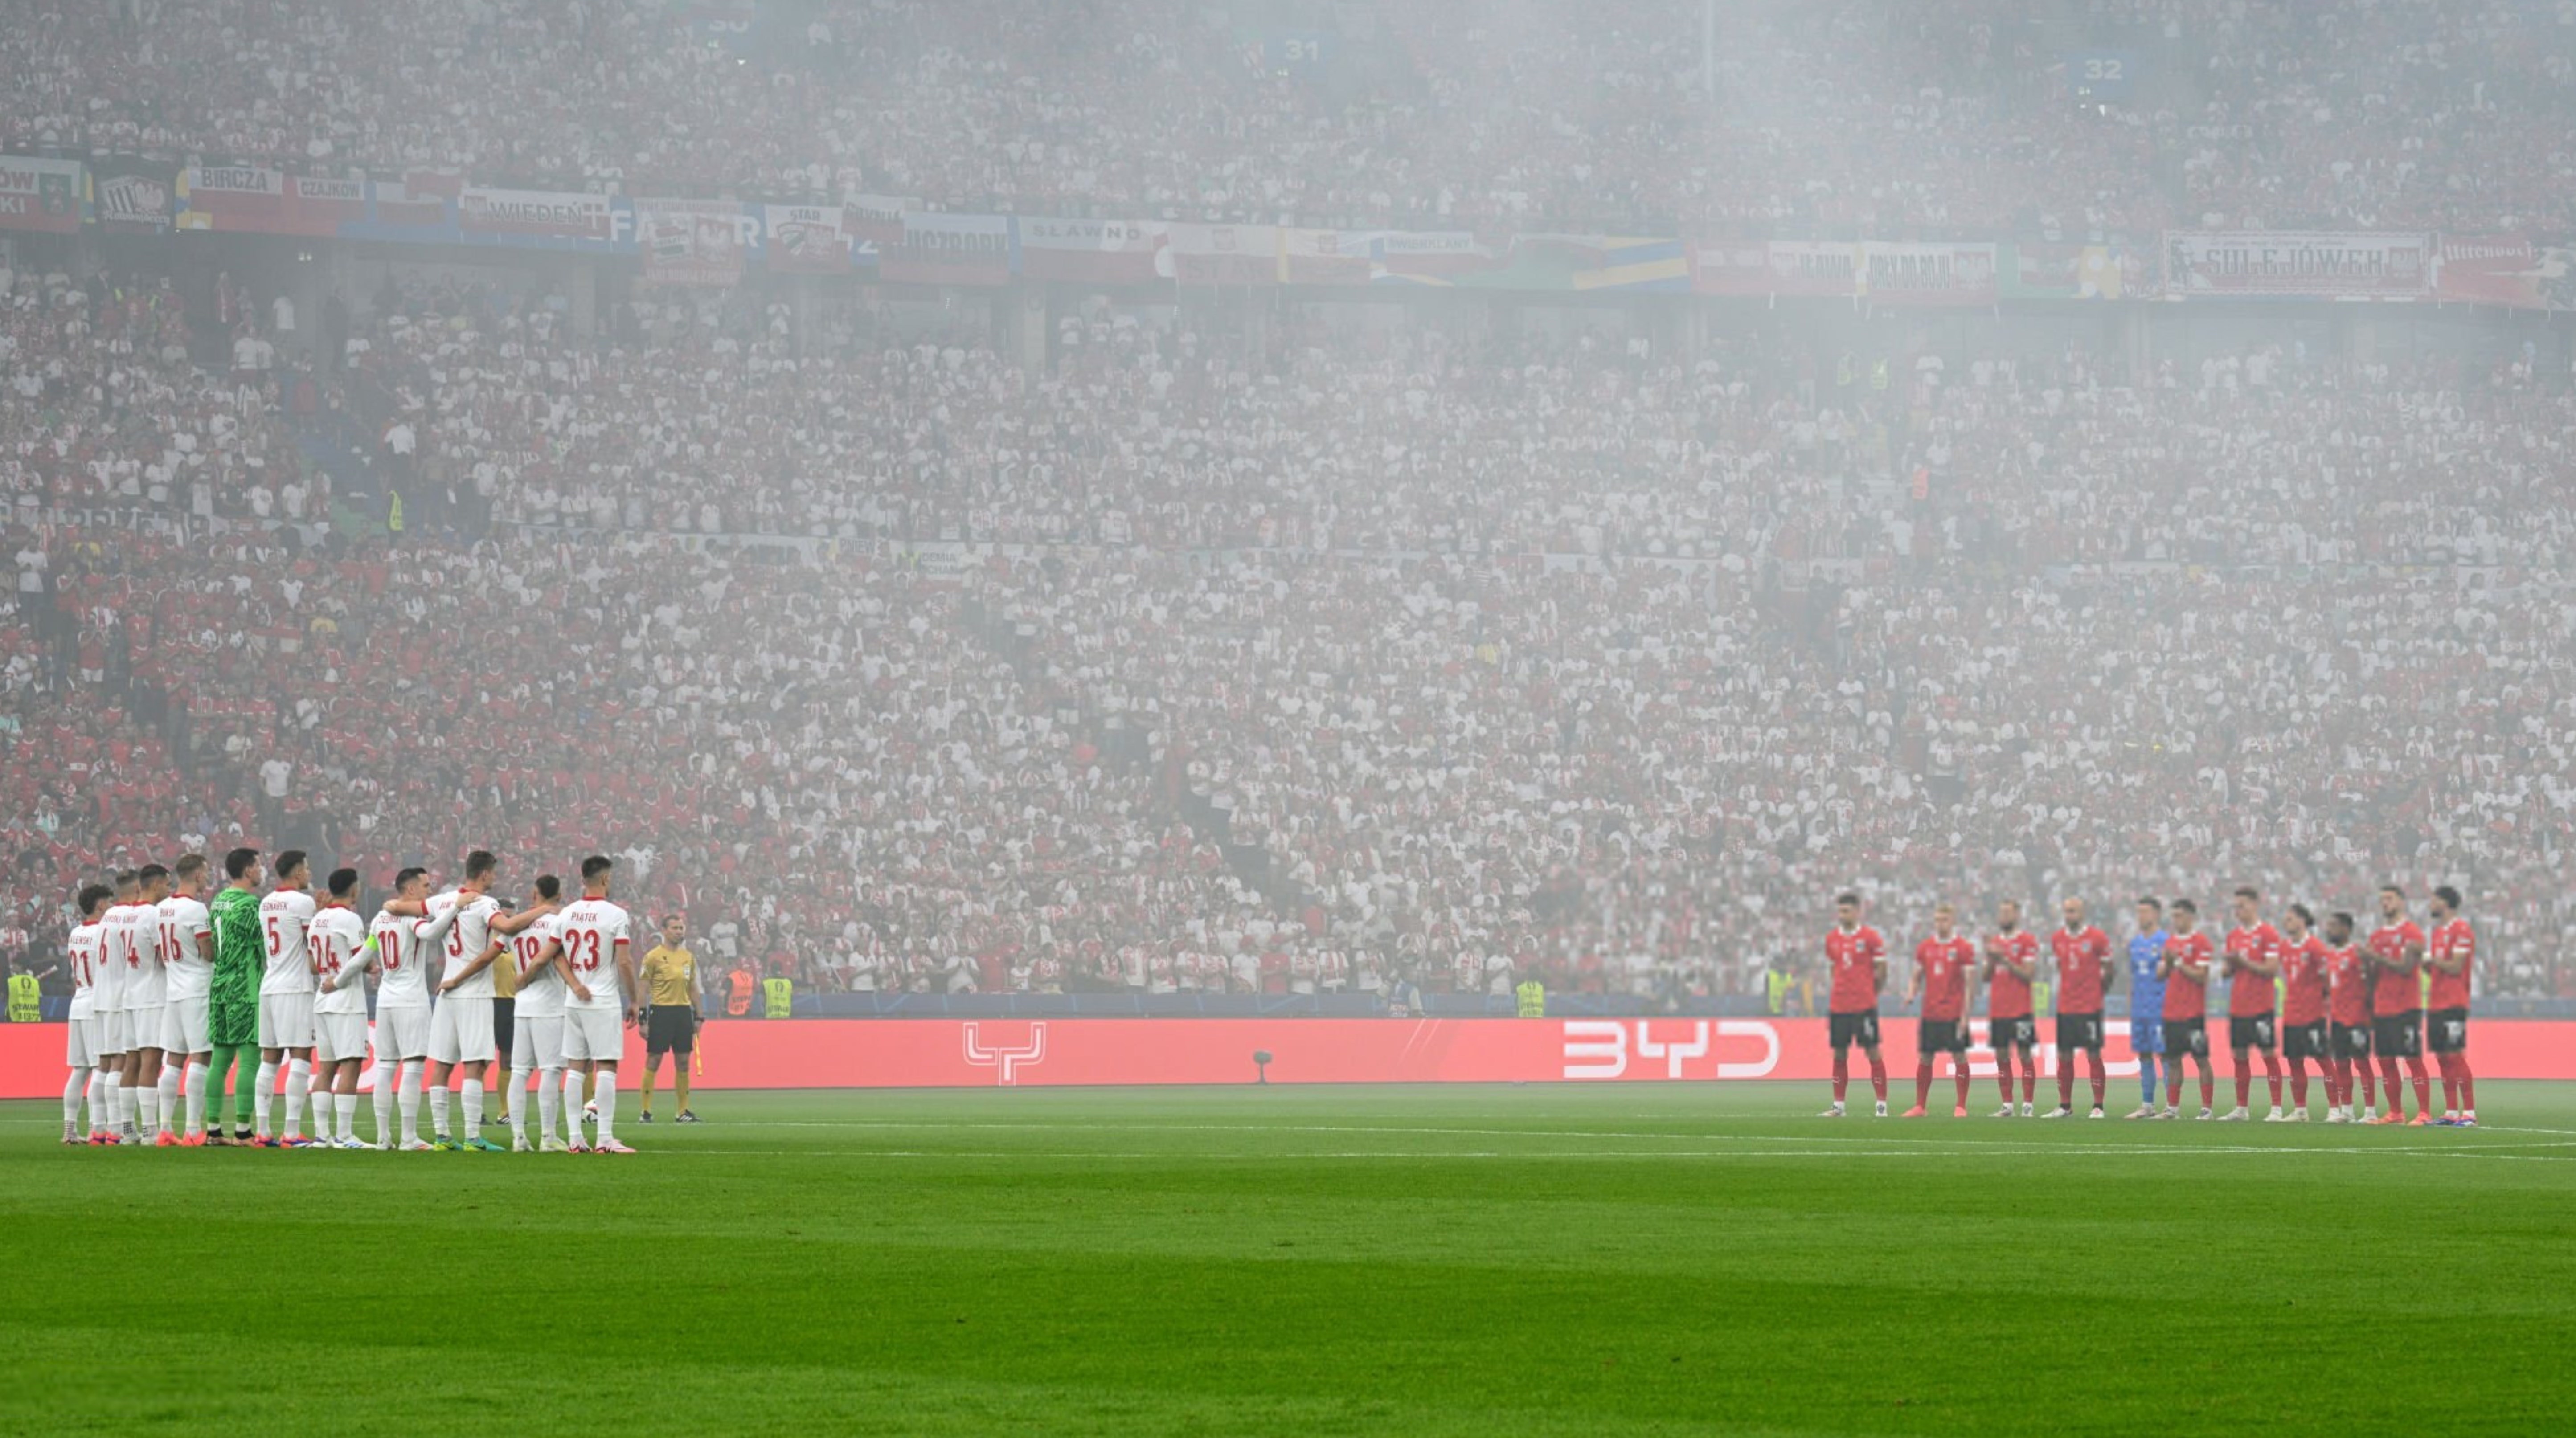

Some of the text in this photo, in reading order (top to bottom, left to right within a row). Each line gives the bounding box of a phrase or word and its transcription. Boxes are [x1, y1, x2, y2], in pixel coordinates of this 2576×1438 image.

[1286, 39, 1318, 62] 31
[2085, 59, 2122, 80] 32
[201, 168, 268, 191] BIRCZA
[489, 201, 582, 223] WIEDEŃ
[790, 209, 821, 221] STAR
[1032, 225, 1140, 240] SŁAWNO
[214, 915, 222, 956] 1
[268, 917, 281, 956] 5
[571, 911, 598, 923] PIĄTEK
[99, 928, 108, 966] 6
[119, 929, 139, 969] 14
[159, 922, 184, 963] 16
[311, 934, 341, 975] 24
[377, 929, 400, 972] 10
[448, 917, 463, 957] 3
[565, 929, 600, 972] 23
[1564, 1021, 1780, 1078] BYD
